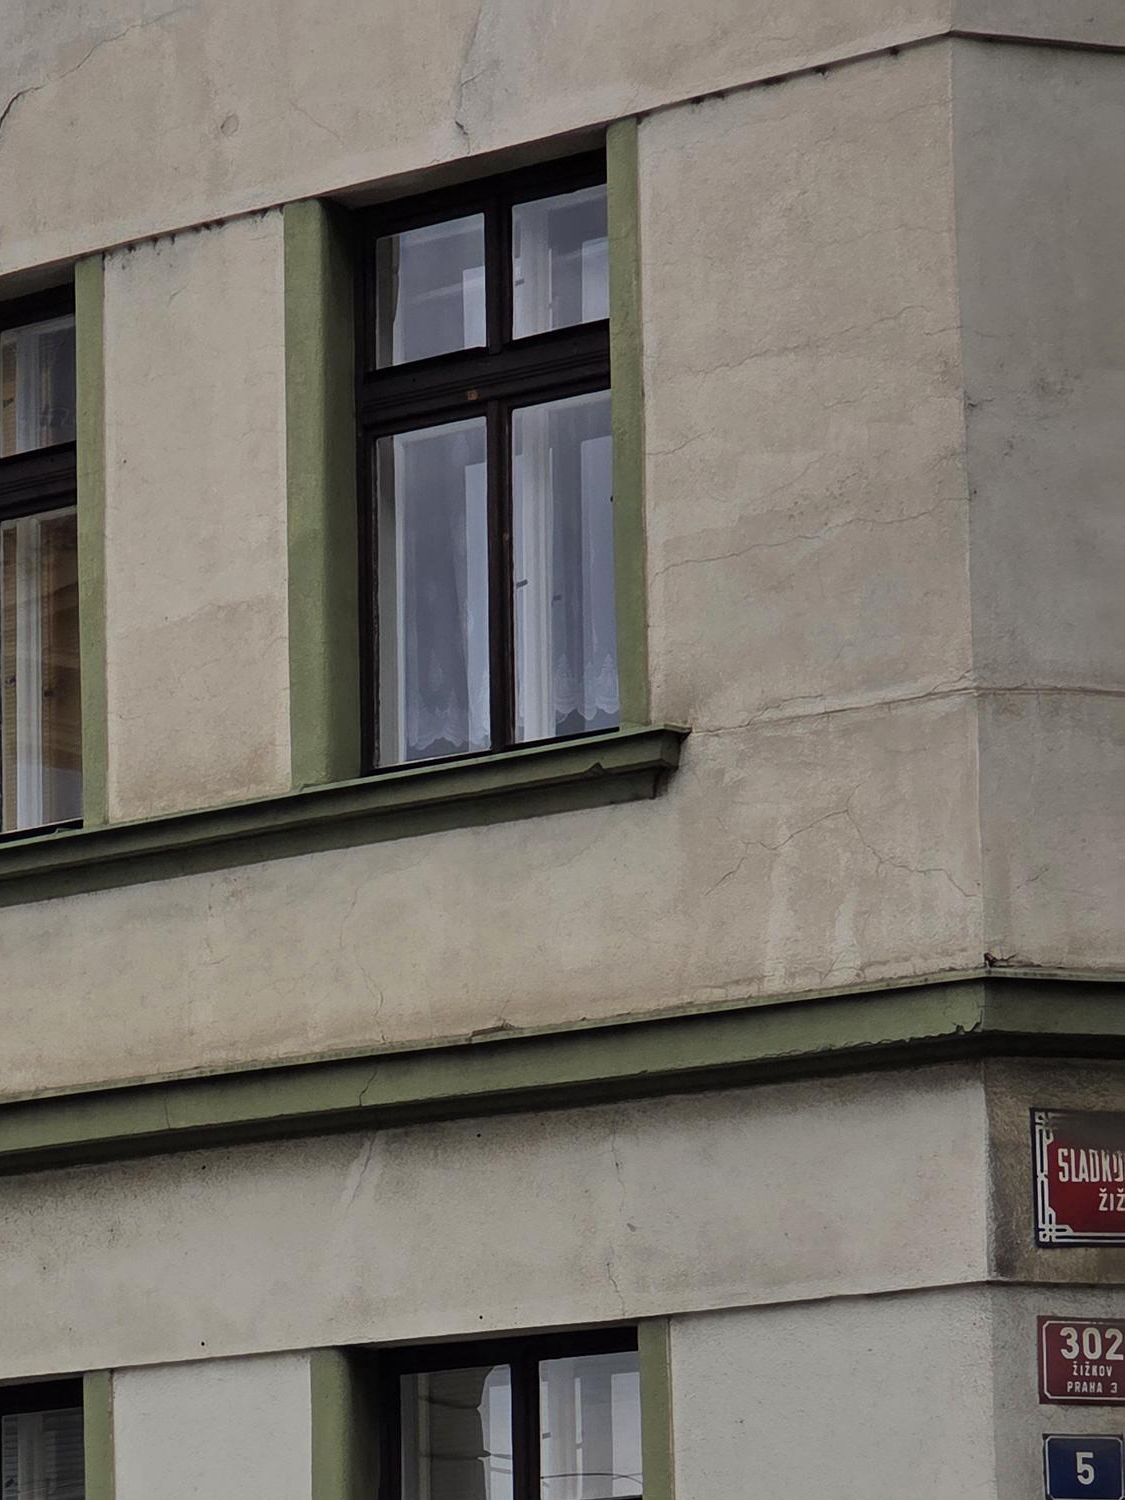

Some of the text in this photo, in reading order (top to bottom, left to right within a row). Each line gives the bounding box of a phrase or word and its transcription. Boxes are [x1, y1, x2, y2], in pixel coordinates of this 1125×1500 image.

[1060, 1327, 1124, 1360] 302
[1072, 1361, 1113, 1377] ŽIŽKOV
[1067, 1381, 1118, 1393] PRAHA 3
[1075, 1452, 1095, 1485] 5
